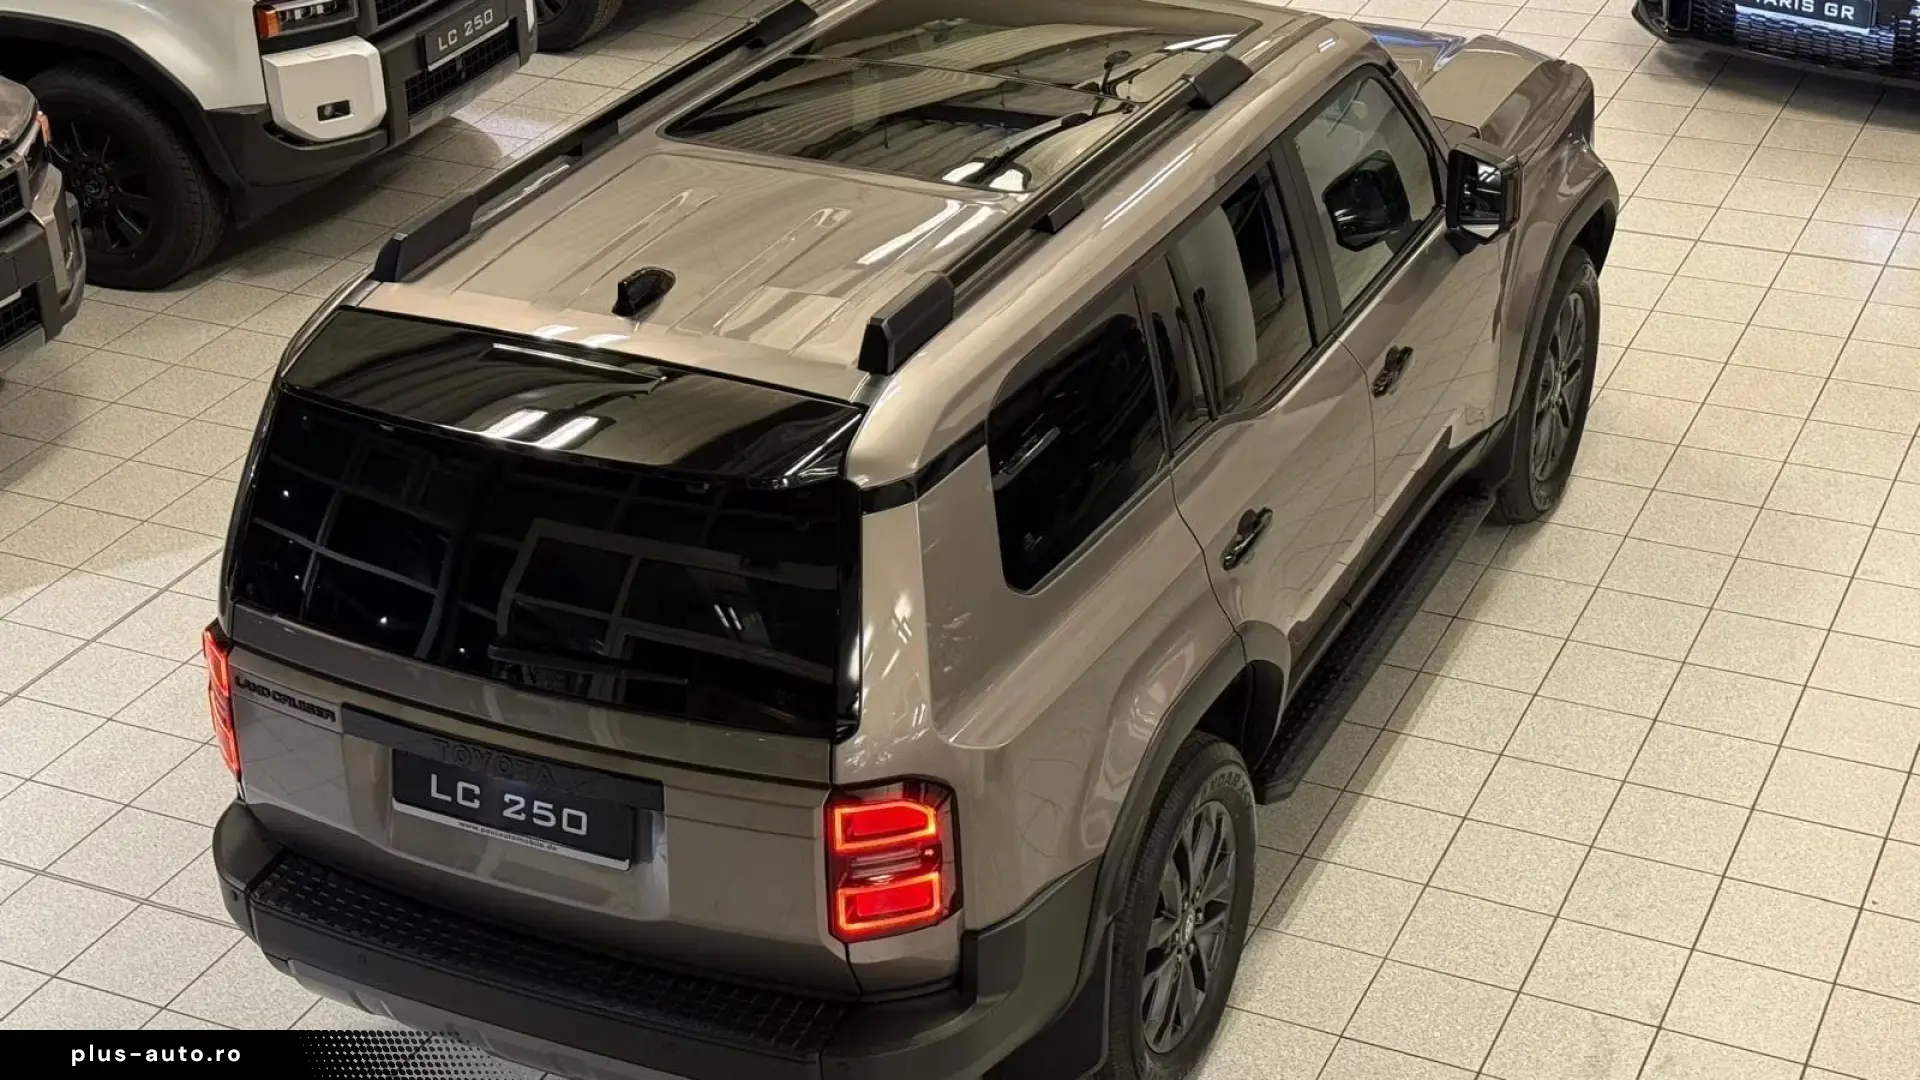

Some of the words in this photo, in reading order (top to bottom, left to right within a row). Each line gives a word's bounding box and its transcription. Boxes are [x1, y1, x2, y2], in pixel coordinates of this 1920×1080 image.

[437, 29, 458, 51] LC
[463, 8, 494, 37] 250
[1755, 0, 1815, 13] ARIS
[1823, 2, 1855, 20] GR
[234, 675, 271, 699] LAND
[271, 690, 337, 723] CRUISER
[433, 737, 557, 787] TOYOTA
[430, 773, 481, 809] LC
[502, 793, 588, 836] 250
